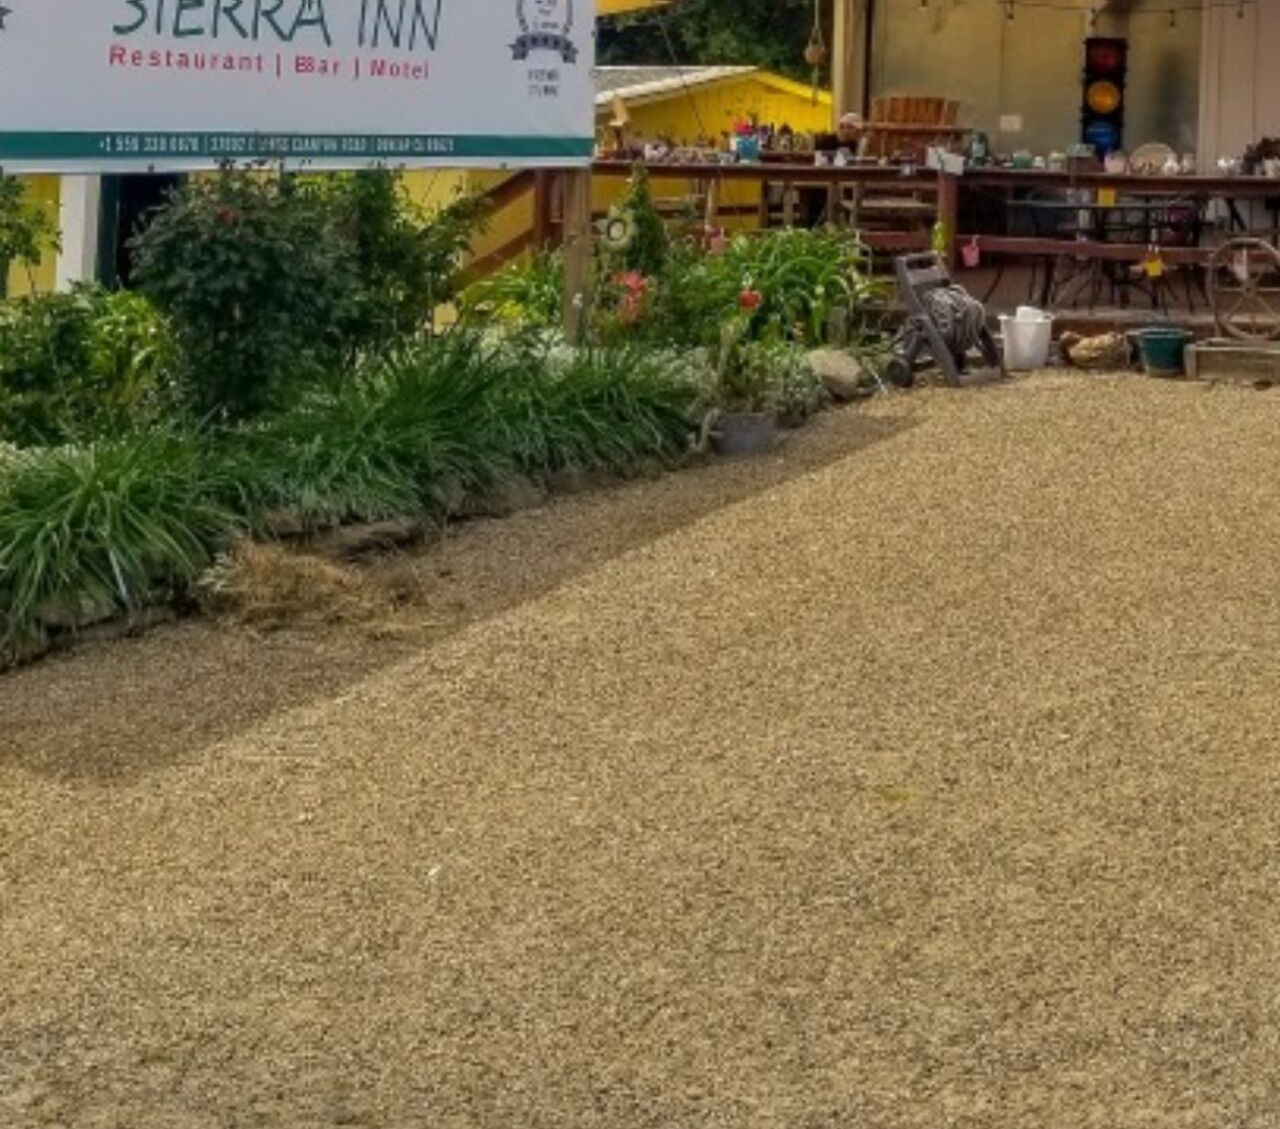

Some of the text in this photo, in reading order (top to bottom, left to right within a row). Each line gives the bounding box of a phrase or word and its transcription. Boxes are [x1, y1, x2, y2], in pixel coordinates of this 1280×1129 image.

[108, 45, 430, 80] Restaurant Bar Motel
